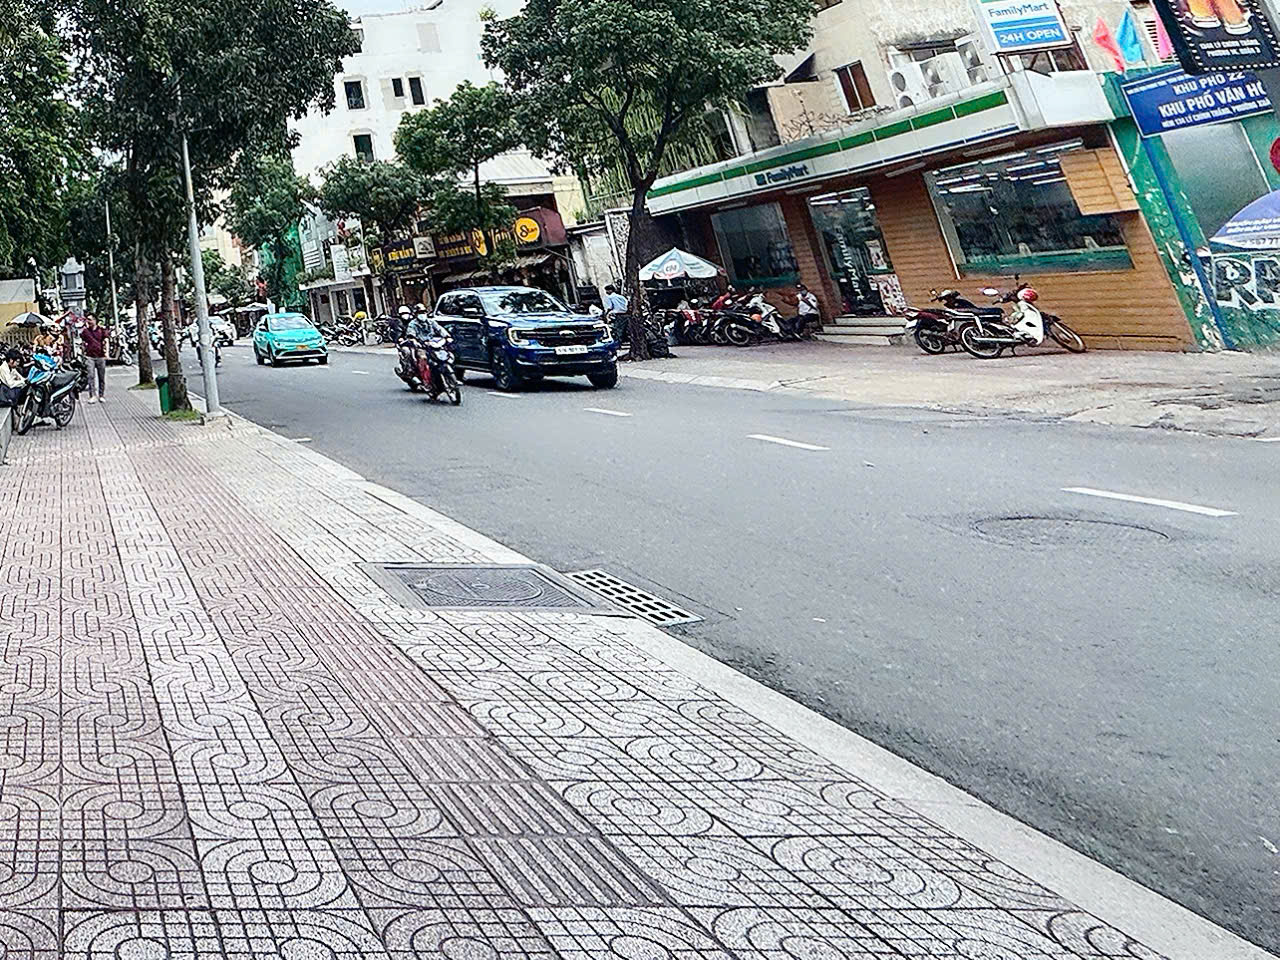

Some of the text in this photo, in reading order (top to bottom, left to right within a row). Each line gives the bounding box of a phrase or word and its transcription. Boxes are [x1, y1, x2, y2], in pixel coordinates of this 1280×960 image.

[988, 3, 1050, 17] FamilyMart
[1000, 28, 1061, 43] 24H OPEN
[1173, 81, 1198, 95] KHU
[1158, 102, 1185, 118] KHU
[1186, 90, 1216, 111] PHỐ
[1215, 86, 1247, 104] VĂN
[766, 164, 810, 184] FamilyMart
